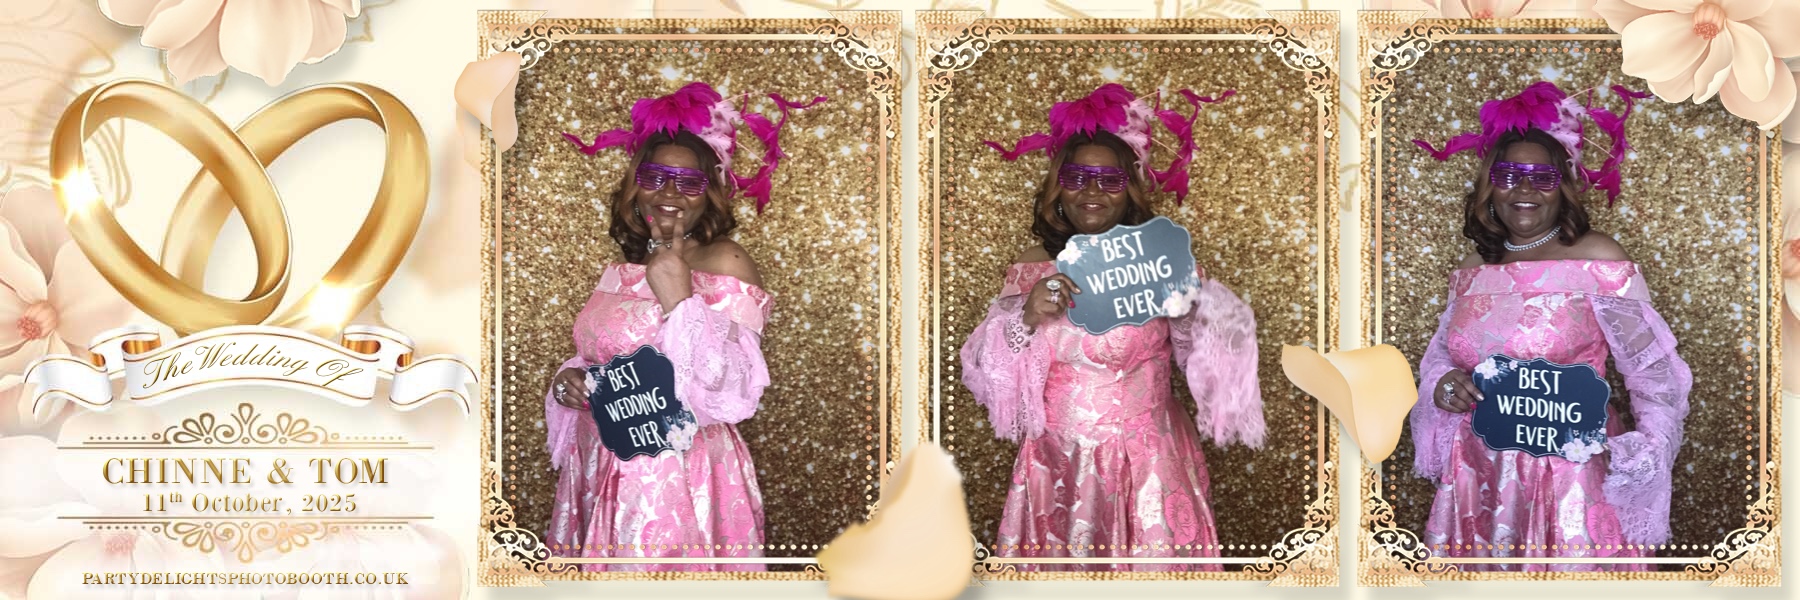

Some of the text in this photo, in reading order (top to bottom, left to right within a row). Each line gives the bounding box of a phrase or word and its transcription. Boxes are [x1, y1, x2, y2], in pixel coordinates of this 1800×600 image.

[1101, 231, 1144, 262] BEST
[1086, 255, 1172, 295] WEDDING
[1113, 289, 1162, 319] EVER
[607, 361, 641, 392] BEST
[1518, 367, 1563, 395] BEST
[604, 386, 668, 422] WEDDING
[1496, 394, 1582, 423] WEDDING
[628, 421, 669, 448] EVER
[1516, 424, 1561, 453] EVER
